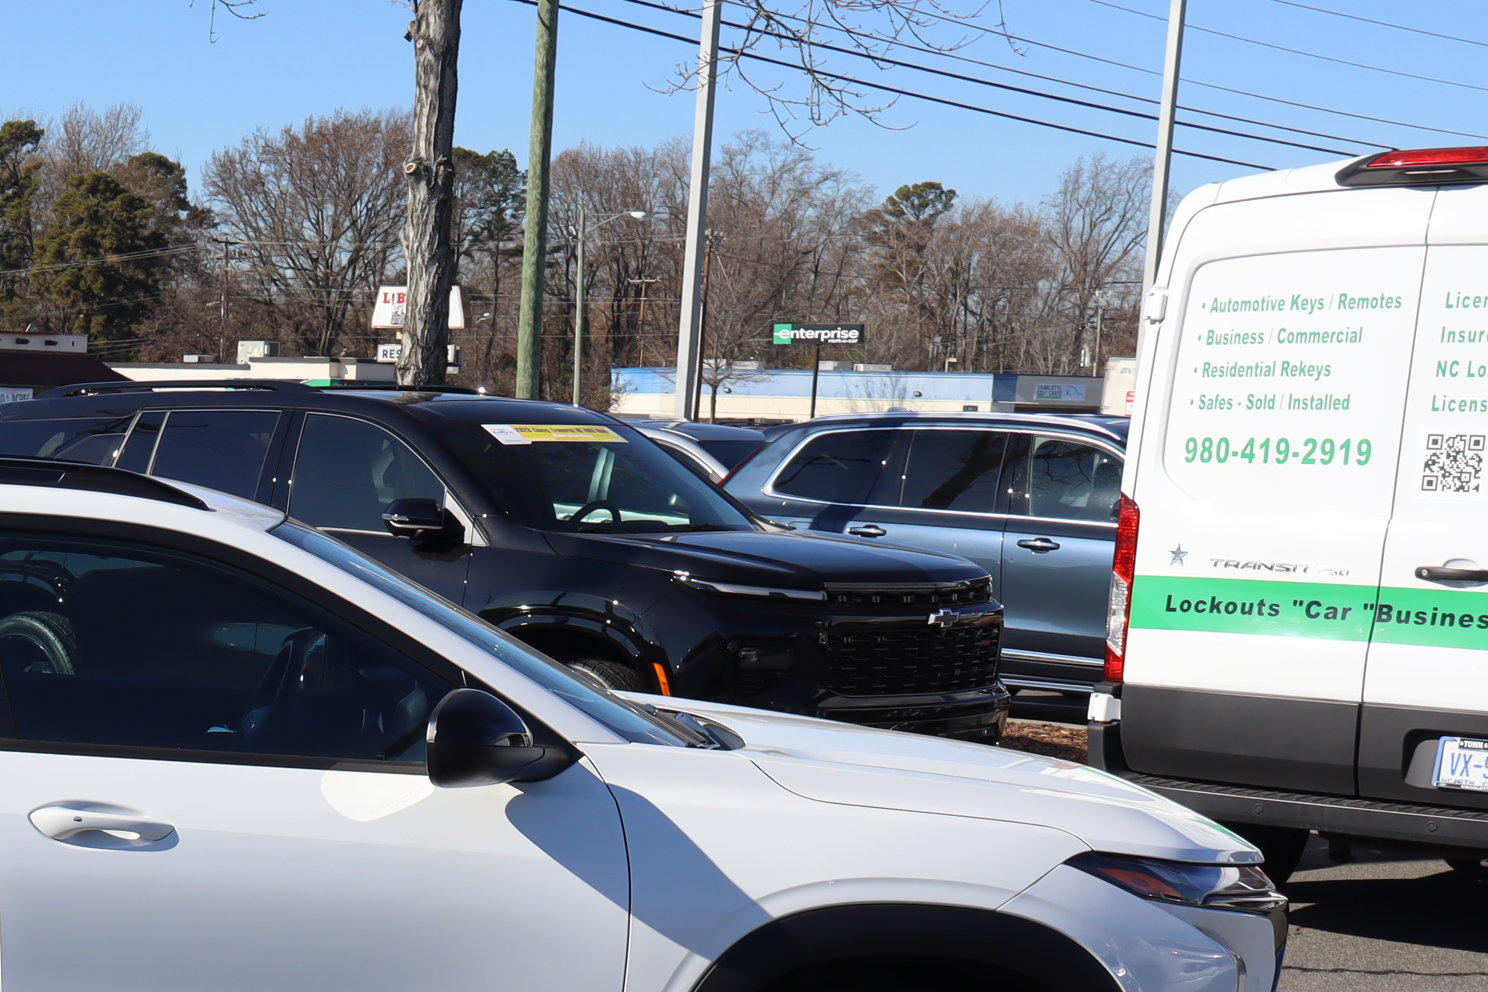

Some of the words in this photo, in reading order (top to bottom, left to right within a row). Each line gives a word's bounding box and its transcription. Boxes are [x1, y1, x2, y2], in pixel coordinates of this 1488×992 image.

[1209, 295, 1286, 313] Automotive
[1290, 294, 1325, 315] Keys
[1338, 293, 1402, 310] Remotes
[776, 327, 859, 342] enterprise
[1206, 329, 1264, 346] Business
[1277, 326, 1363, 344] Commercial
[1440, 326, 1488, 343] Insur
[382, 349, 401, 359] RES
[1202, 360, 1276, 378] Residential
[1280, 360, 1331, 382] Rekeys
[1436, 360, 1460, 378] NC
[1467, 360, 1487, 378] Lo
[1198, 394, 1233, 410] Safes
[1246, 393, 1276, 410] Sold
[1288, 393, 1351, 410] Installed
[1431, 394, 1488, 412] Licens
[1184, 436, 1372, 466] 980-419-2919
[1210, 558, 1309, 574] TRANSIT
[1165, 594, 1281, 618] Lockouts
[1292, 599, 1352, 622] "Car
